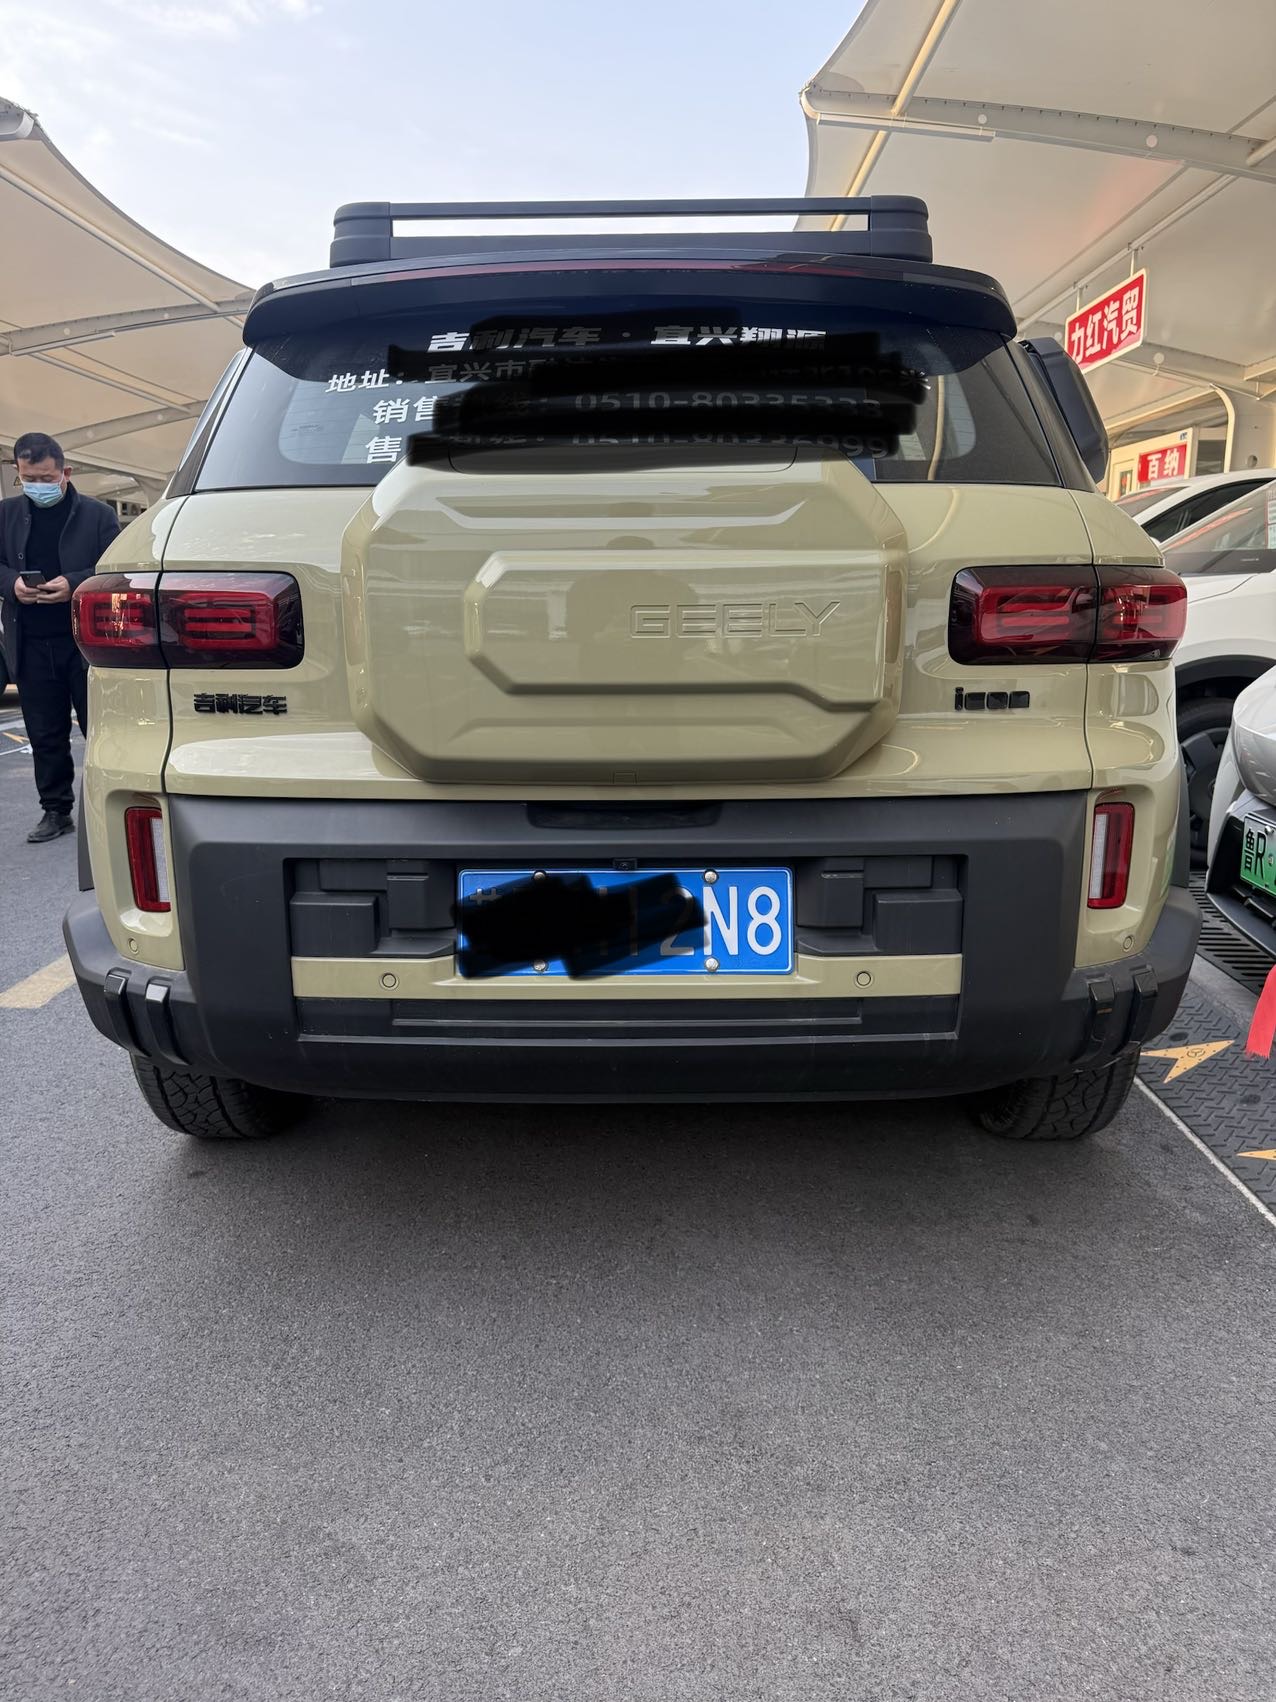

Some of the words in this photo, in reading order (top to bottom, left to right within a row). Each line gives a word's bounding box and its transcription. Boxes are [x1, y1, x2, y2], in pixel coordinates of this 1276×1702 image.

[1070, 286, 1140, 364] 力红汽贸
[1147, 449, 1180, 480] 百纳
[630, 601, 841, 639] GEELY
[193, 692, 287, 715] 吉利汽车
